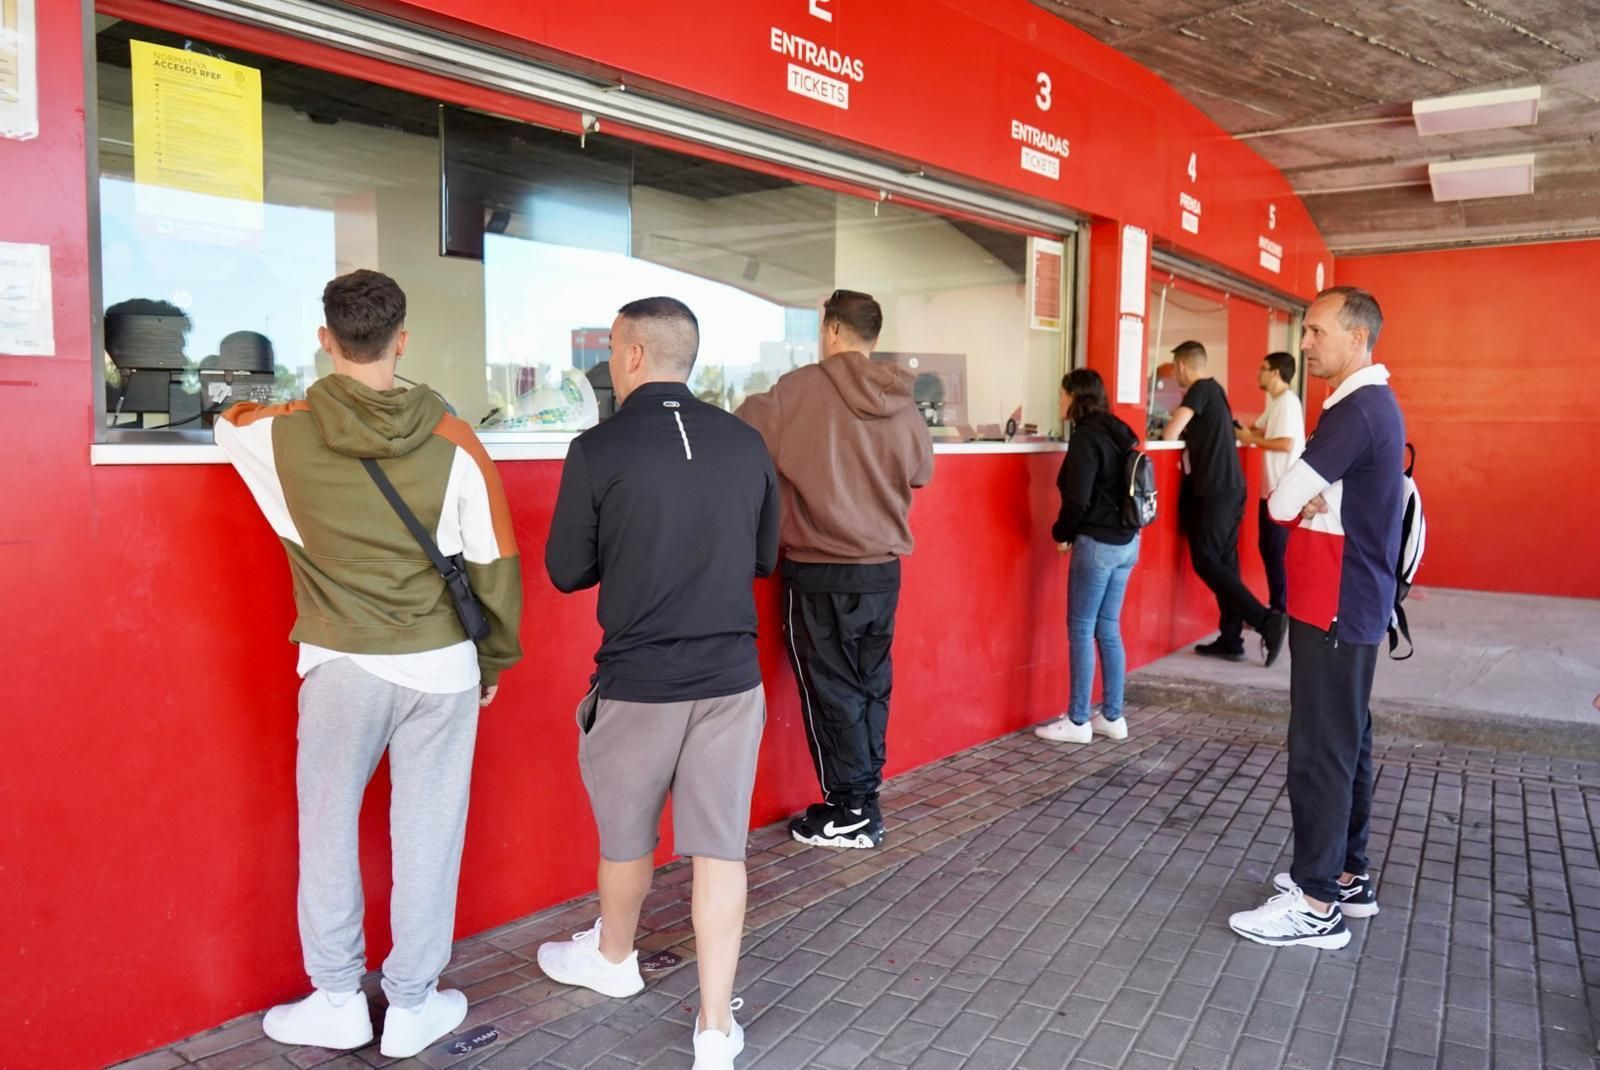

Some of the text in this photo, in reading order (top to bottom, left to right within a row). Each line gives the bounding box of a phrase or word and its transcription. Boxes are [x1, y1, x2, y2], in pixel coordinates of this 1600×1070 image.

[771, 26, 864, 82] ENTRADAS
[154, 60, 198, 75] ACCESOS
[199, 69, 222, 81] RFEF
[791, 70, 846, 103] TICKETS
[1035, 71, 1052, 112] 3
[1011, 118, 1070, 158] ENTRADAS
[1024, 151, 1058, 176] TICKETS
[1187, 151, 1197, 183] 4
[1268, 203, 1277, 231] 5
